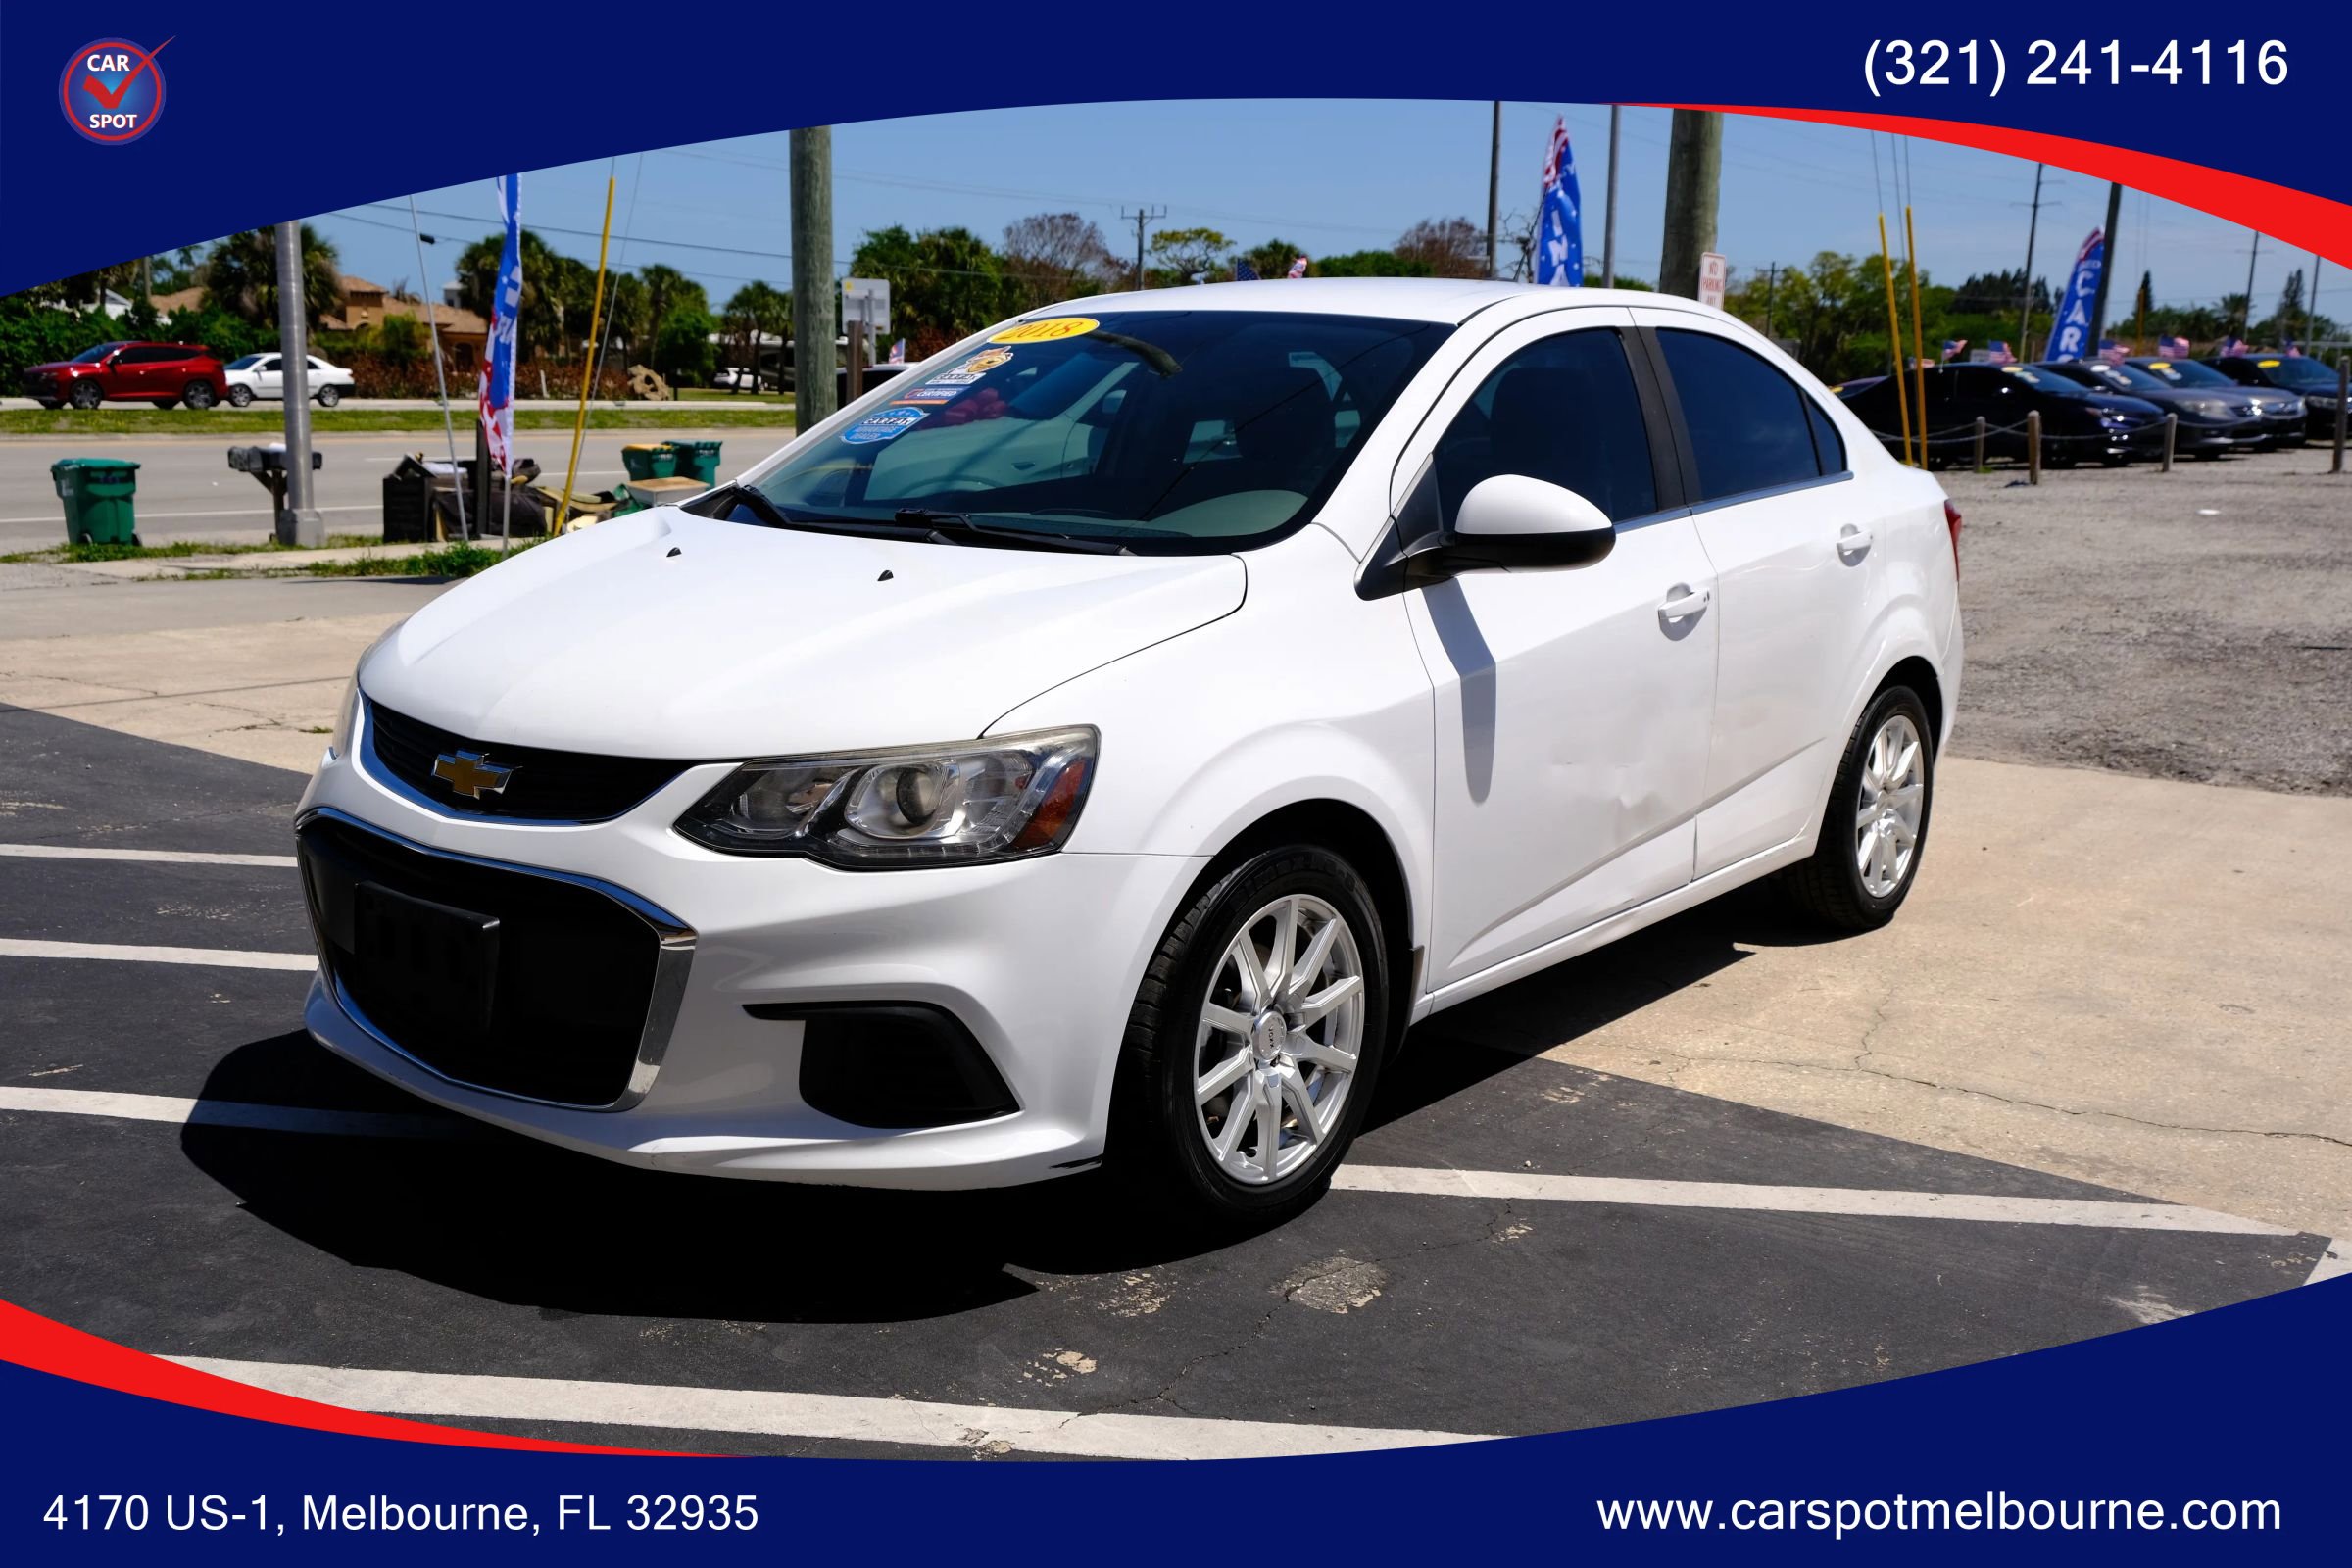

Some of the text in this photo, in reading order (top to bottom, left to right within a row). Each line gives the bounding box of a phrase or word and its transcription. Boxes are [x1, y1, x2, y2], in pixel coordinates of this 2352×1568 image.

[2057, 270, 2096, 363] CAR
[997, 321, 1083, 340] 2018
[860, 416, 914, 425] CARFAX
